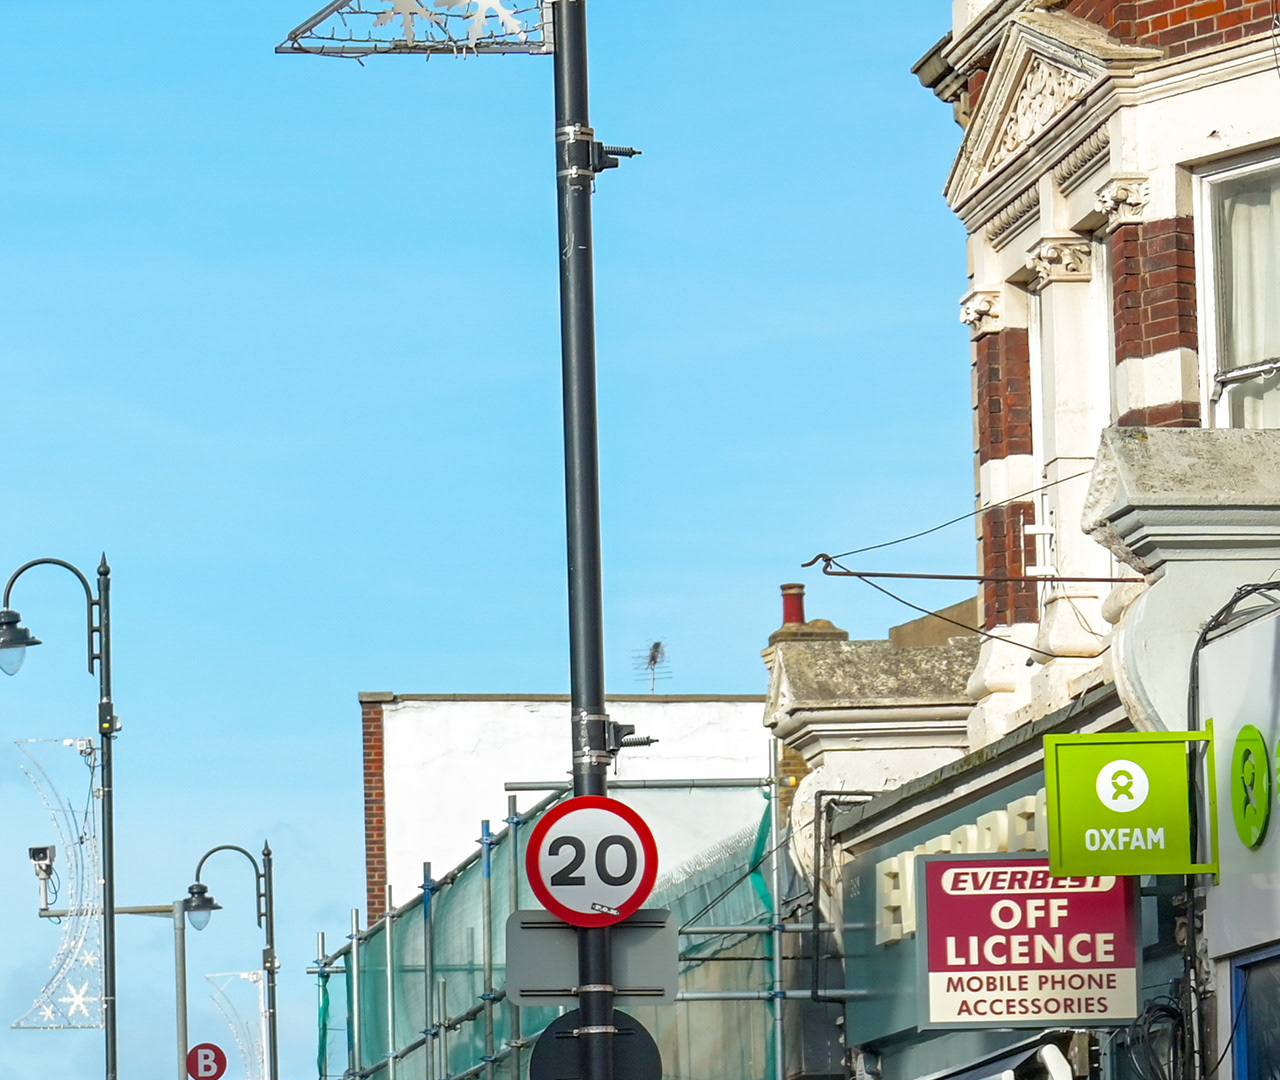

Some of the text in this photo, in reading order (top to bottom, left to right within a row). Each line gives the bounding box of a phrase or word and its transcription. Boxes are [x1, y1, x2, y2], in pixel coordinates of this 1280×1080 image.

[1085, 827, 1165, 851] OXFAM
[548, 834, 638, 887] 20
[990, 898, 1069, 930] OFF
[946, 932, 1116, 966] LICENCE
[946, 973, 1117, 993] MOBILE PHONE
[957, 997, 1108, 1017] ACCESSORIES
[197, 1048, 219, 1078] B
